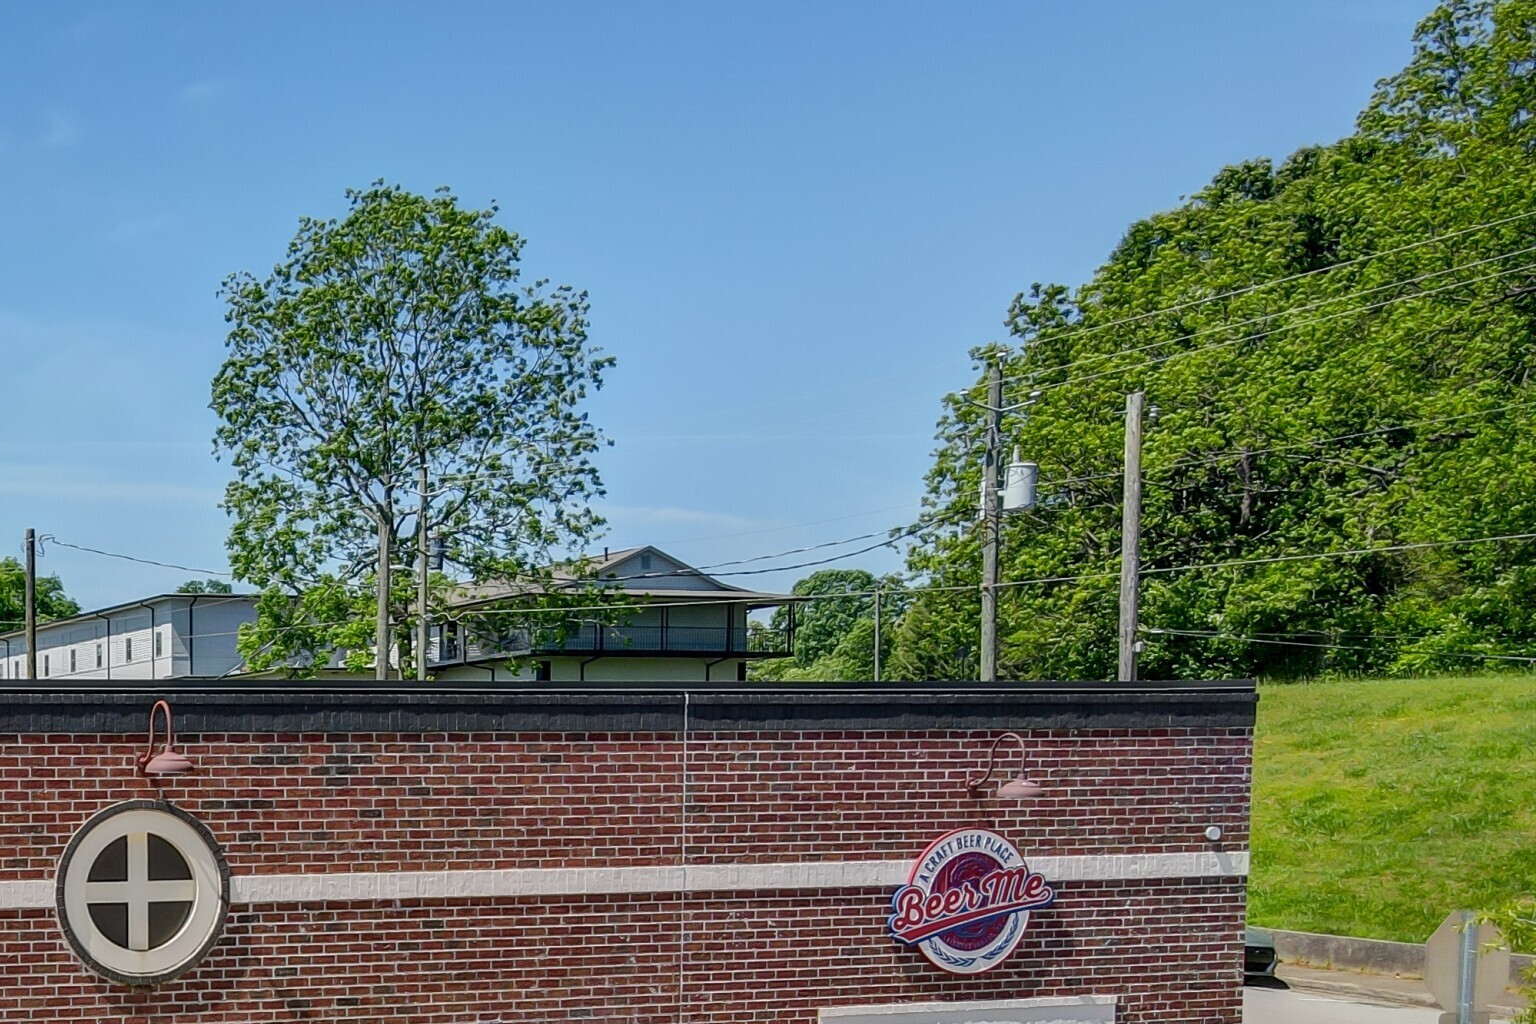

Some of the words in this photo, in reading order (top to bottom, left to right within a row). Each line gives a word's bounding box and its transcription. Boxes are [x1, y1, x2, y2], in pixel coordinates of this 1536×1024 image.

[919, 873, 931, 884] A
[925, 841, 954, 873] CRAFT
[956, 834, 982, 850] BEER
[984, 836, 1014, 864] PLACE
[892, 881, 983, 931] Beer
[979, 866, 1053, 908] Me
